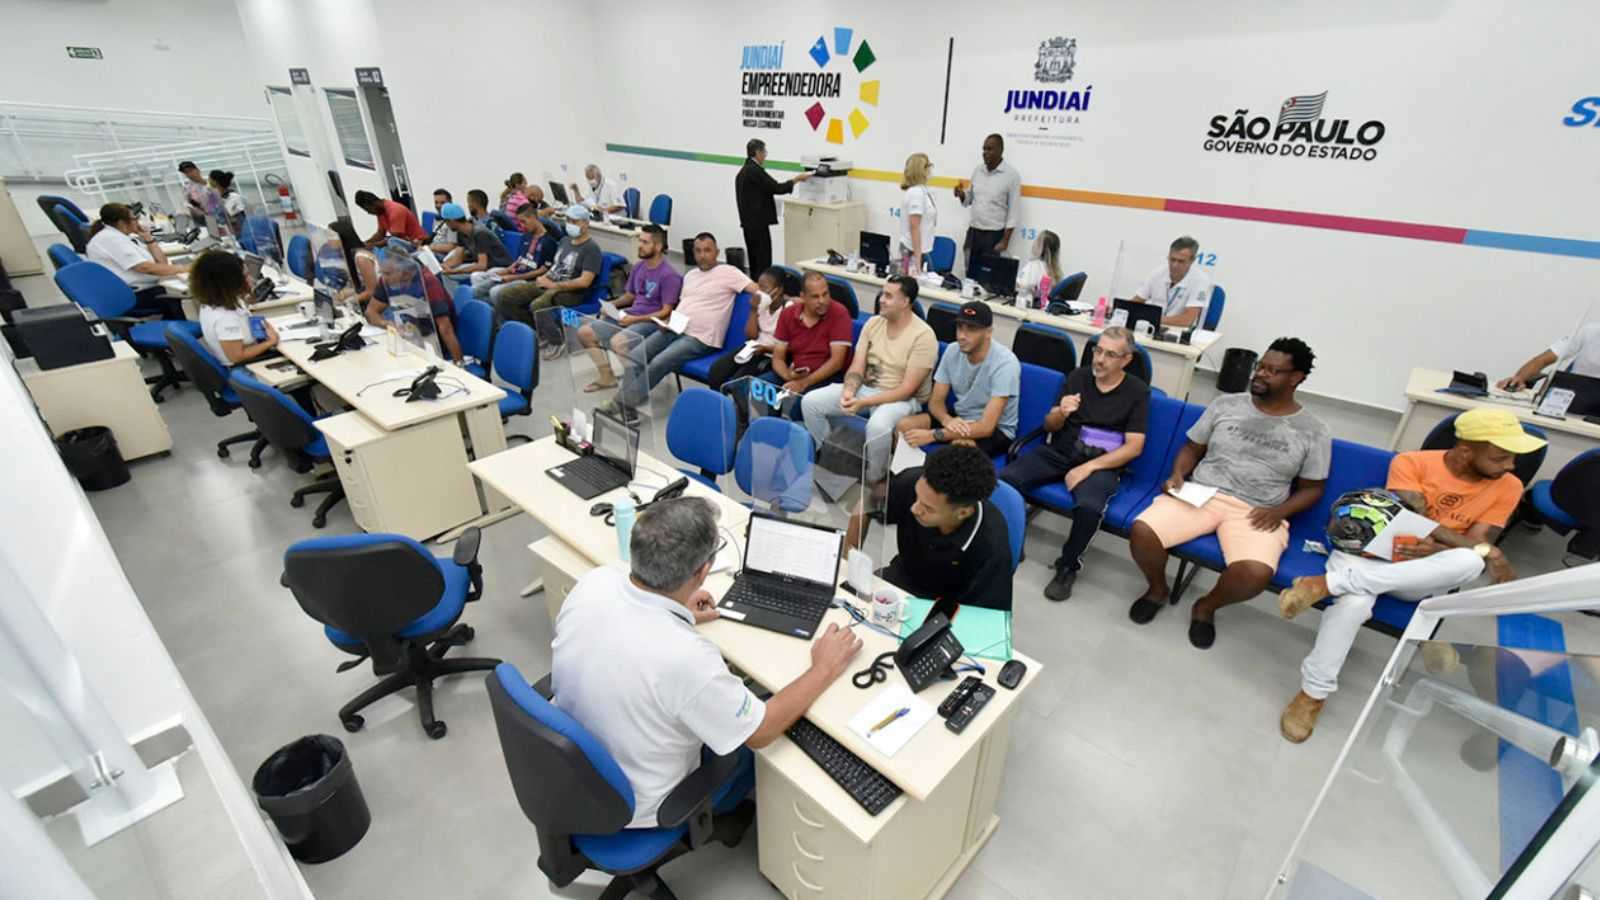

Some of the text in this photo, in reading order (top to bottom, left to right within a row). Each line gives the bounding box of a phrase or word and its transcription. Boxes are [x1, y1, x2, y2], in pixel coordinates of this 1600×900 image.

[740, 40, 785, 69] JUNDIAÍ
[741, 72, 841, 97] EMPREENDEDORA
[1004, 85, 1092, 113] JUNDIAÍ
[1014, 114, 1080, 124] PREFEITURA
[1207, 109, 1386, 146] SÃO PAULO
[1203, 139, 1377, 161] GOVERNO DO ESTADO
[889, 206, 901, 217] 14
[1020, 226, 1038, 240] 13
[1197, 252, 1217, 266] 12
